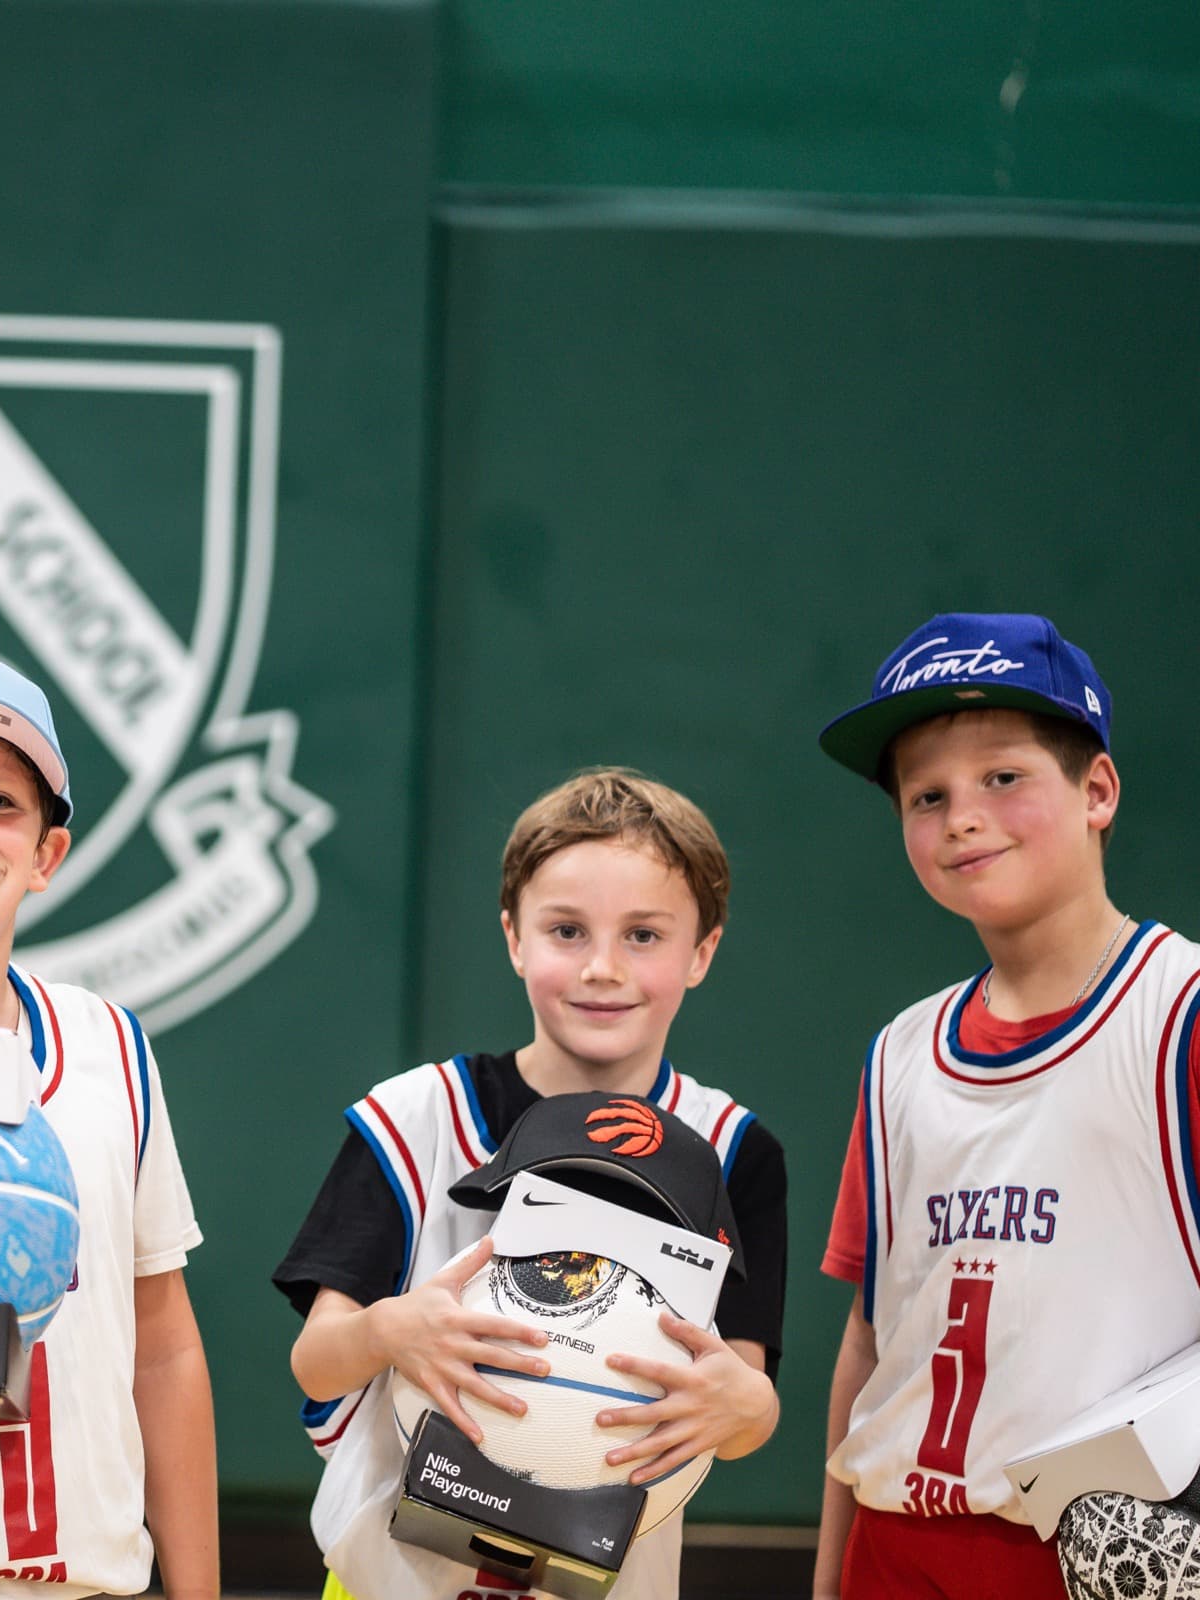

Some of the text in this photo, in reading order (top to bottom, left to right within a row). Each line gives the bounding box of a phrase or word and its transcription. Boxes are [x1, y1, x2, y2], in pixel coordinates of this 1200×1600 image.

[880, 637, 1025, 693] Toronto
[544, 1330, 596, 1354] EATNESS
[425, 1452, 461, 1477] Nike
[419, 1467, 511, 1513] Playground
